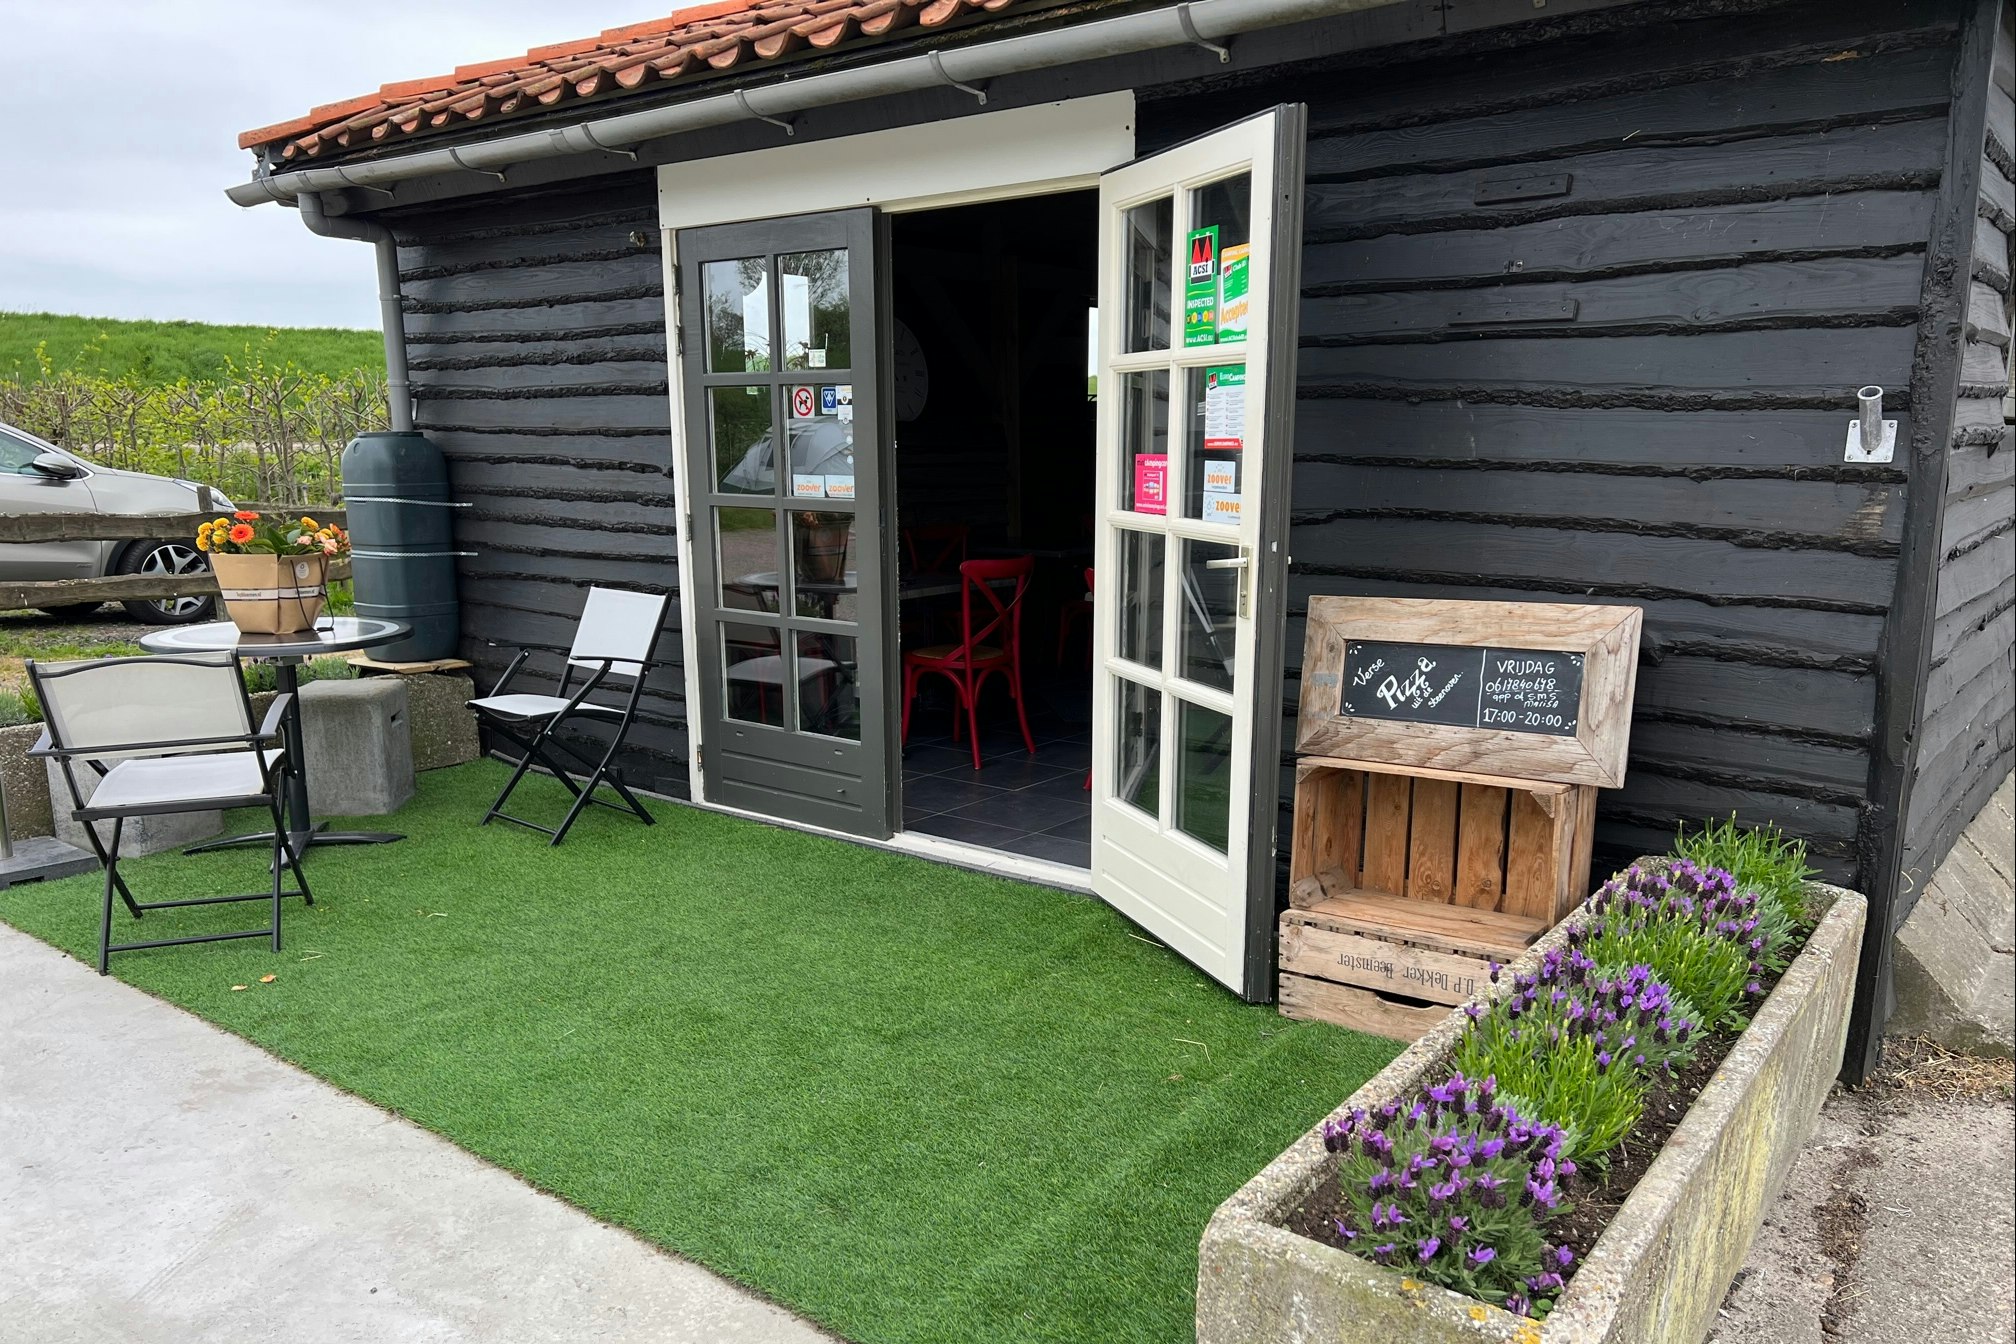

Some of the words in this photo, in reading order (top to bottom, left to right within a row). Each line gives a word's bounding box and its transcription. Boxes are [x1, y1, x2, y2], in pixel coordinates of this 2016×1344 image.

[1193, 263, 1209, 276] ACSI
[1187, 297, 1214, 309] INSPECTED
[1207, 473, 1232, 485] zoover
[797, 483, 821, 492] zoover
[828, 484, 854, 493] zoover
[1215, 500, 1240, 513] zoove
[1352, 658, 1385, 686] Verse
[1497, 660, 1555, 676] VRIJDAG
[1377, 656, 1437, 711] Pizza
[1411, 697, 1424, 709] uit
[1423, 687, 1434, 698] de
[1493, 692, 1511, 703] app
[1337, 953, 1394, 979] Beemster
[1403, 966, 1448, 991] Dekker
